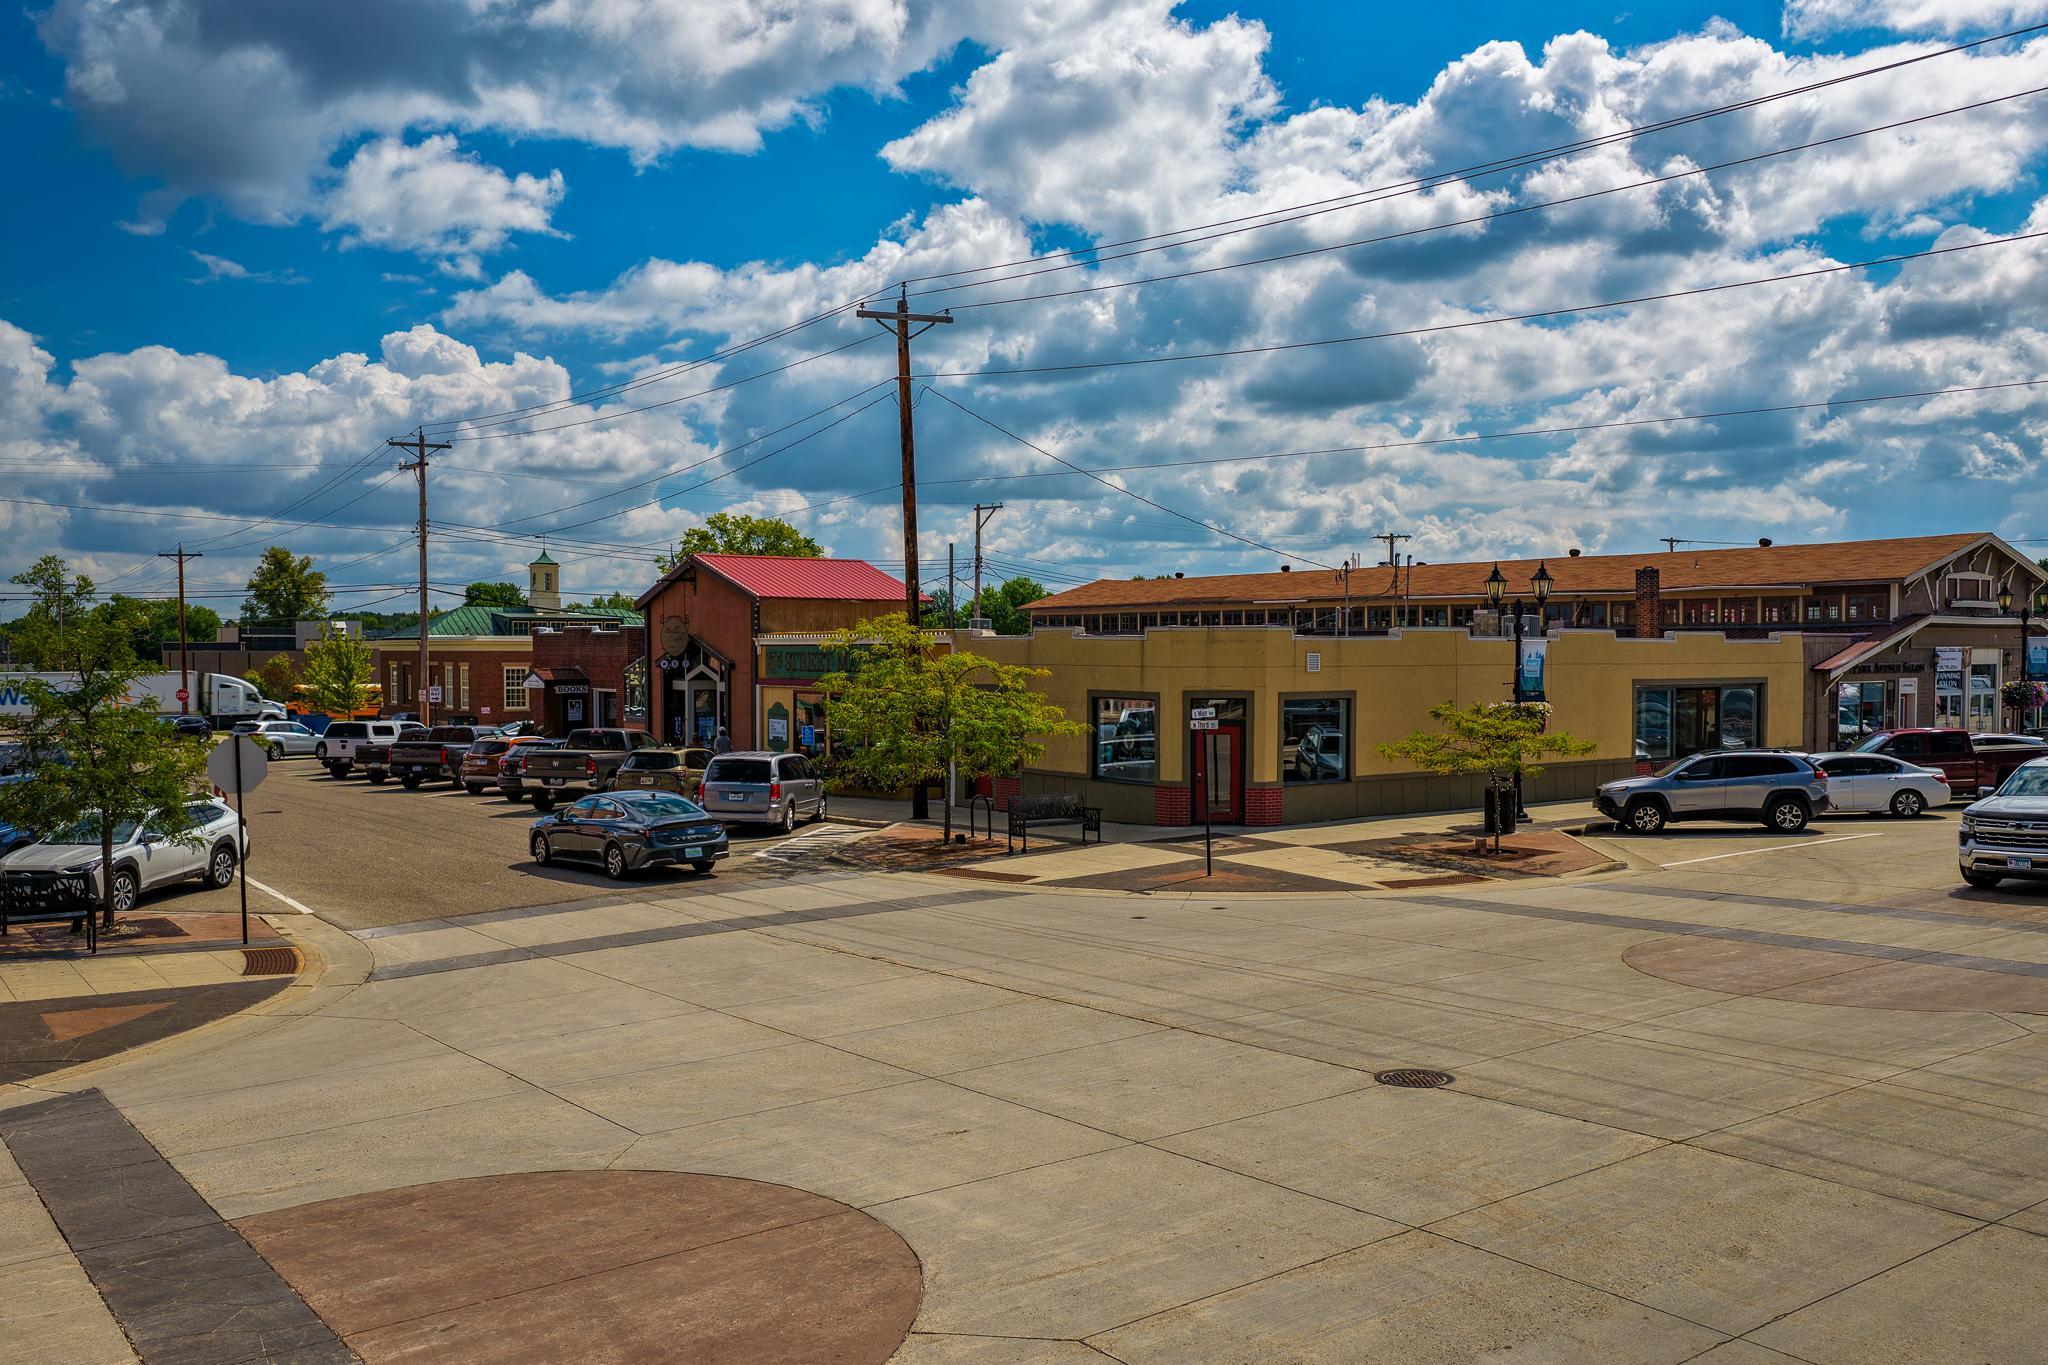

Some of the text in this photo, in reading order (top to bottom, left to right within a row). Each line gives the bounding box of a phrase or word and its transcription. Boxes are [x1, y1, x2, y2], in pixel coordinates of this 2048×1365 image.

[786, 652, 832, 672] STREET
[1903, 662, 1925, 673] SALON
[1936, 672, 1960, 680] TANNING
